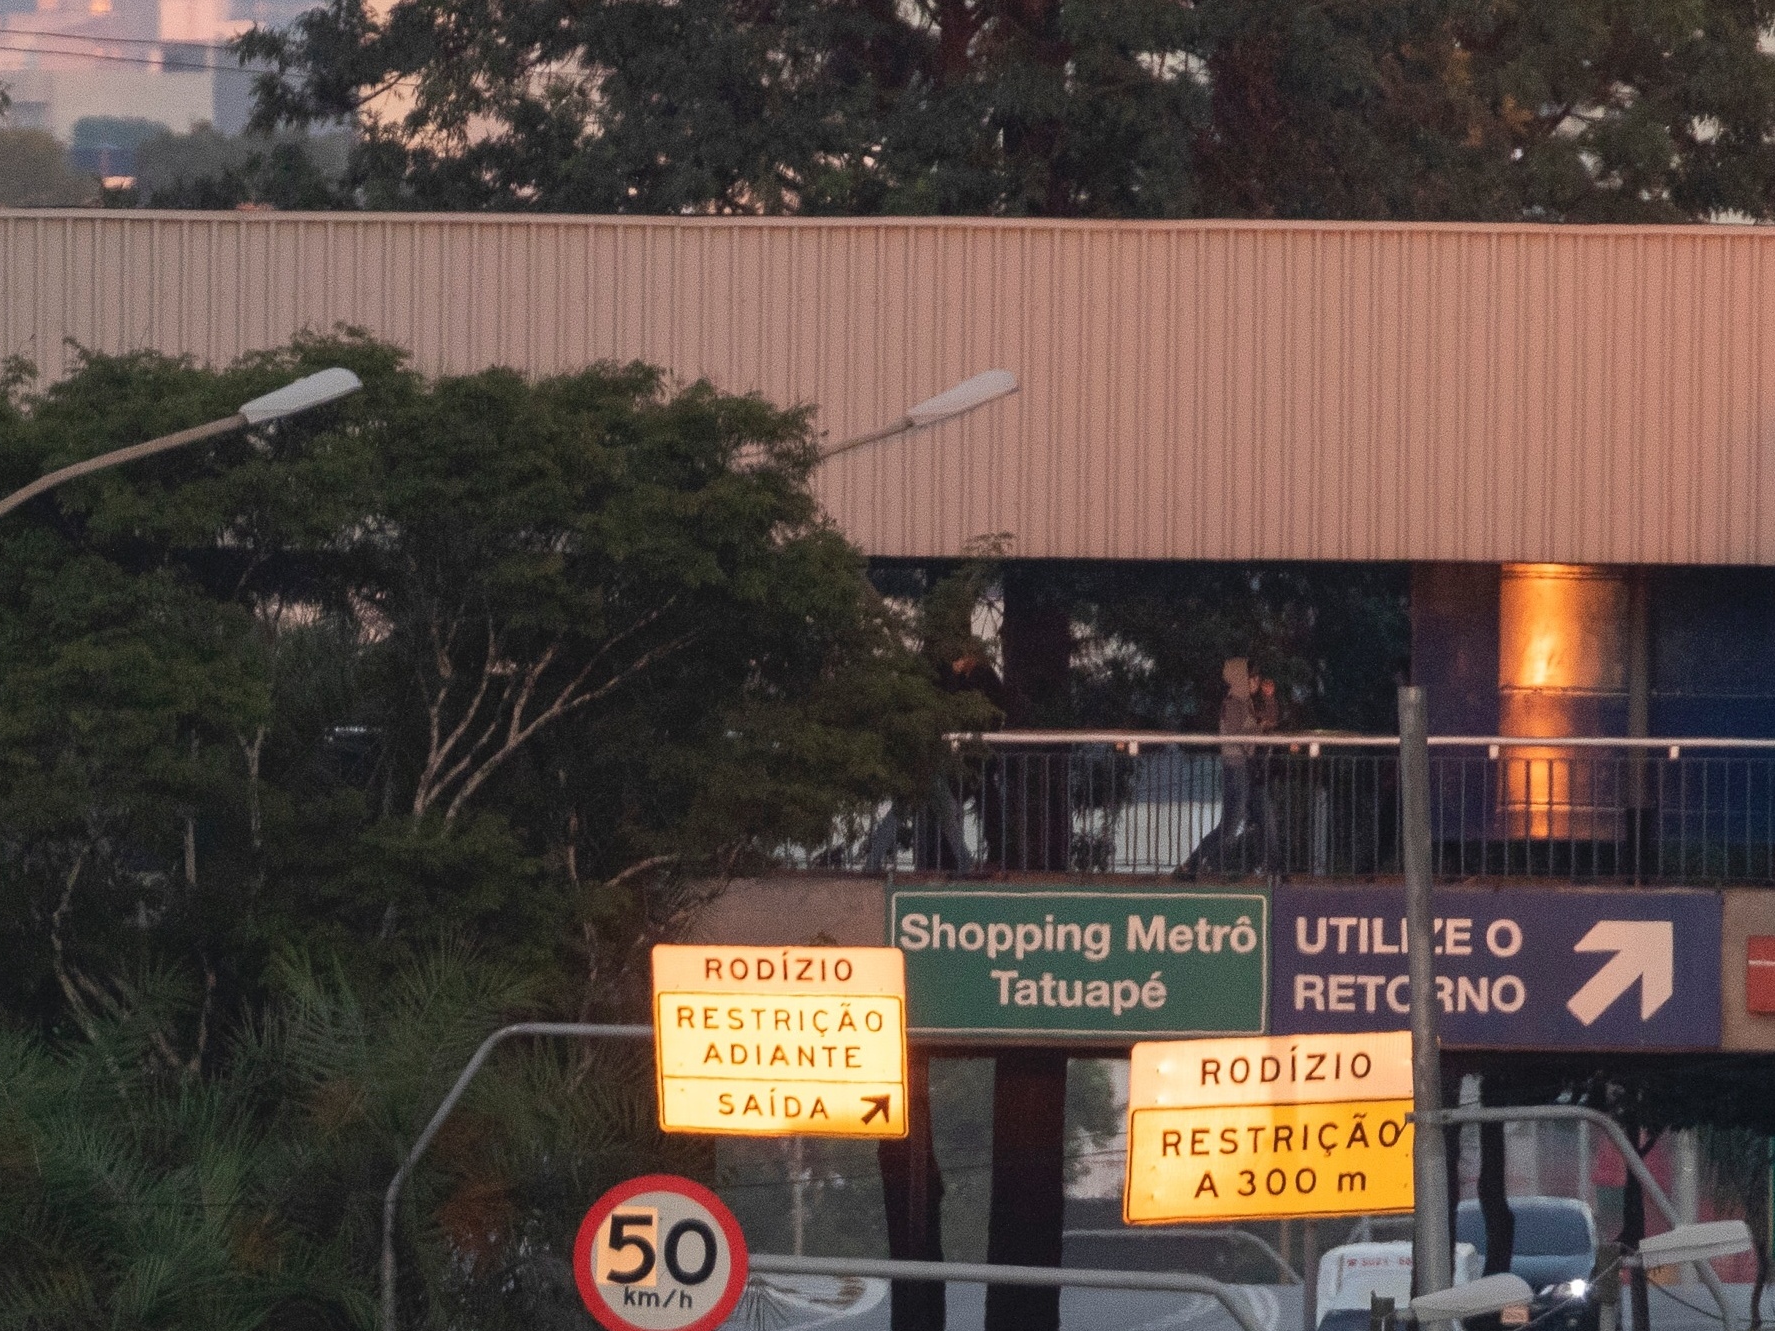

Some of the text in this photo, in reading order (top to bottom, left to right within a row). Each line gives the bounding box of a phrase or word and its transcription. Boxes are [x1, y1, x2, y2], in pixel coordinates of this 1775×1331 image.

[900, 912, 1258, 962] Shopping Metrô
[1486, 917, 1523, 958] O
[705, 951, 853, 982] RODÍZIO
[990, 968, 1167, 1017] Tatuapé
[677, 1003, 884, 1037] RESTRIÇÃO
[703, 1044, 863, 1068] ADIANTE
[1201, 1045, 1372, 1085] RODÍZIO
[719, 1088, 830, 1119] SAÍDA
[1162, 1113, 1400, 1157] RESTRIÇÃO
[1194, 1169, 1366, 1199] A 300 m
[607, 1214, 718, 1286] 50
[623, 1287, 693, 1309] km/h
